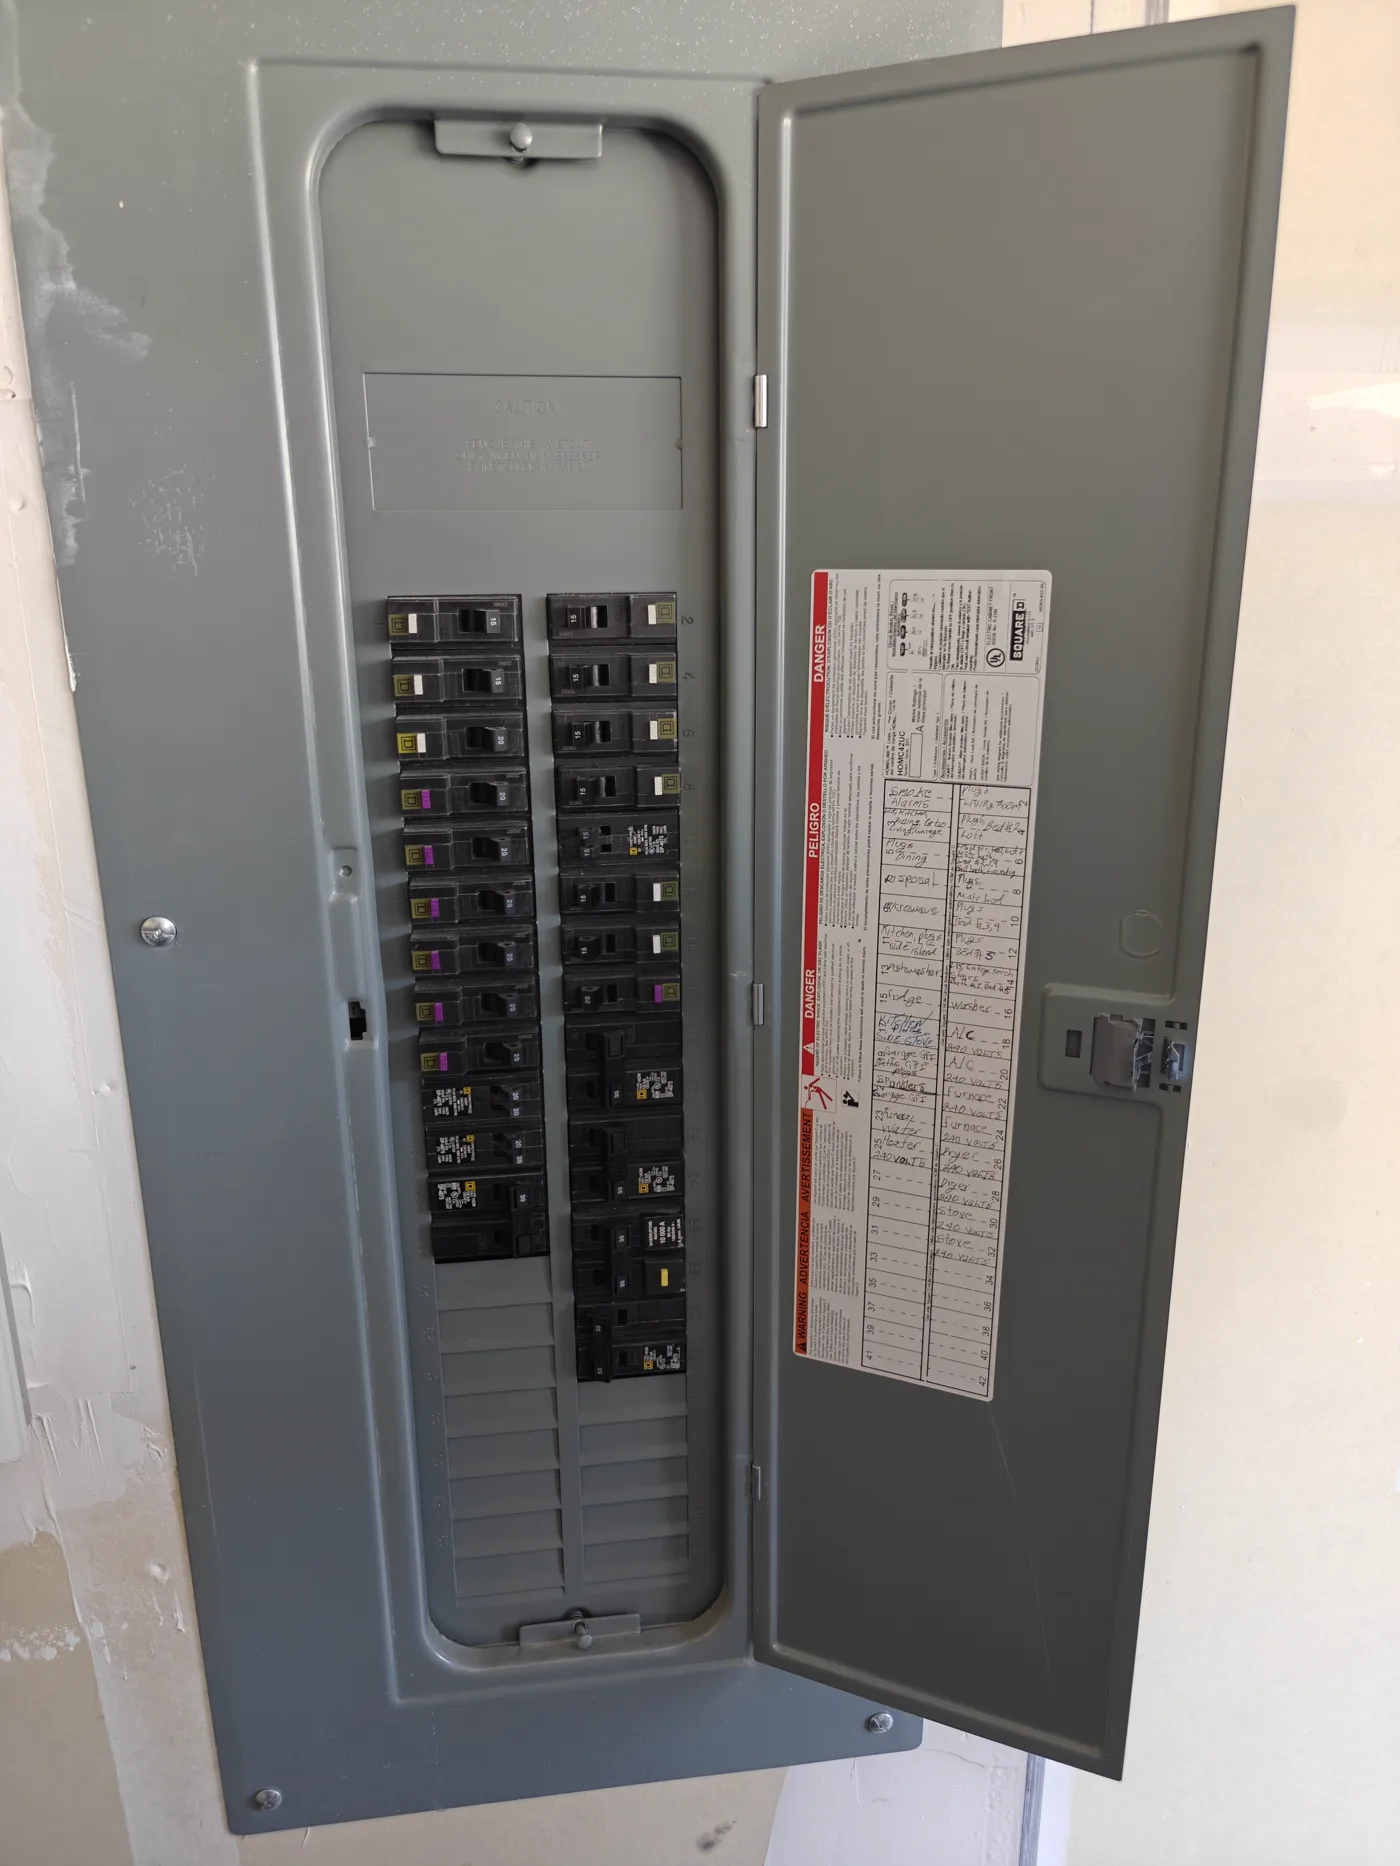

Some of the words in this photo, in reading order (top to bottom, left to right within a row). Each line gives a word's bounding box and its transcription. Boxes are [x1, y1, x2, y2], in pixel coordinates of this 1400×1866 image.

[494, 399, 558, 414] CAUTION
[555, 450, 600, 461] BREAKER
[491, 617, 497, 626] 15
[571, 614, 577, 622] 15
[681, 616, 694, 625] 2
[1012, 612, 1024, 658] SQUARE
[814, 624, 824, 681] DANGER
[495, 677, 502, 686] 15
[682, 672, 694, 681] 4
[575, 731, 581, 739] 15
[682, 729, 694, 738] 6
[498, 736, 504, 744] 20
[500, 792, 506, 800] 20
[808, 802, 819, 857] PELIGRO
[501, 848, 508, 856] 20
[507, 899, 513, 908] 20
[1011, 916, 1019, 926] 10
[507, 953, 513, 961] 20
[1009, 948, 1017, 958] 12
[804, 968, 814, 1018] DANGER
[880, 993, 887, 1003] 15
[585, 996, 591, 1004] 20
[1004, 1009, 1012, 1019] 16
[1002, 1039, 1010, 1048] 18
[514, 1053, 520, 1061] 20
[1000, 1069, 1008, 1080] 20
[512, 1092, 519, 1100] 20
[614, 1090, 620, 1098] 30
[998, 1098, 1006, 1109] 22
[513, 1108, 519, 1116] 20
[876, 1110, 884, 1121] 23
[996, 1130, 1003, 1140] 24
[515, 1140, 522, 1148] 20
[874, 1138, 882, 1149] 25
[517, 1156, 523, 1164] 20
[800, 1111, 811, 1202] AVERTISSEMENT
[994, 1159, 1002, 1170] 26
[873, 1170, 881, 1180] 27
[618, 1186, 623, 1195] 30
[520, 1194, 526, 1202] 30
[992, 1191, 999, 1201] 28
[872, 1196, 880, 1207] 29
[990, 1218, 997, 1229] 30
[871, 1225, 878, 1235] 31
[619, 1235, 625, 1243] 30
[799, 1210, 809, 1284] ADVERTENCIA
[988, 1247, 995, 1257] 32
[870, 1252, 877, 1262] 33
[869, 1278, 876, 1287] 35
[985, 1275, 993, 1285] 34
[868, 1302, 875, 1311] 37
[984, 1302, 992, 1312] 36
[797, 1290, 806, 1339] WARNING
[867, 1324, 874, 1334] 39
[982, 1326, 990, 1337] 38
[866, 1351, 873, 1360] 41
[981, 1350, 988, 1360] 40
[979, 1376, 986, 1386] 42
